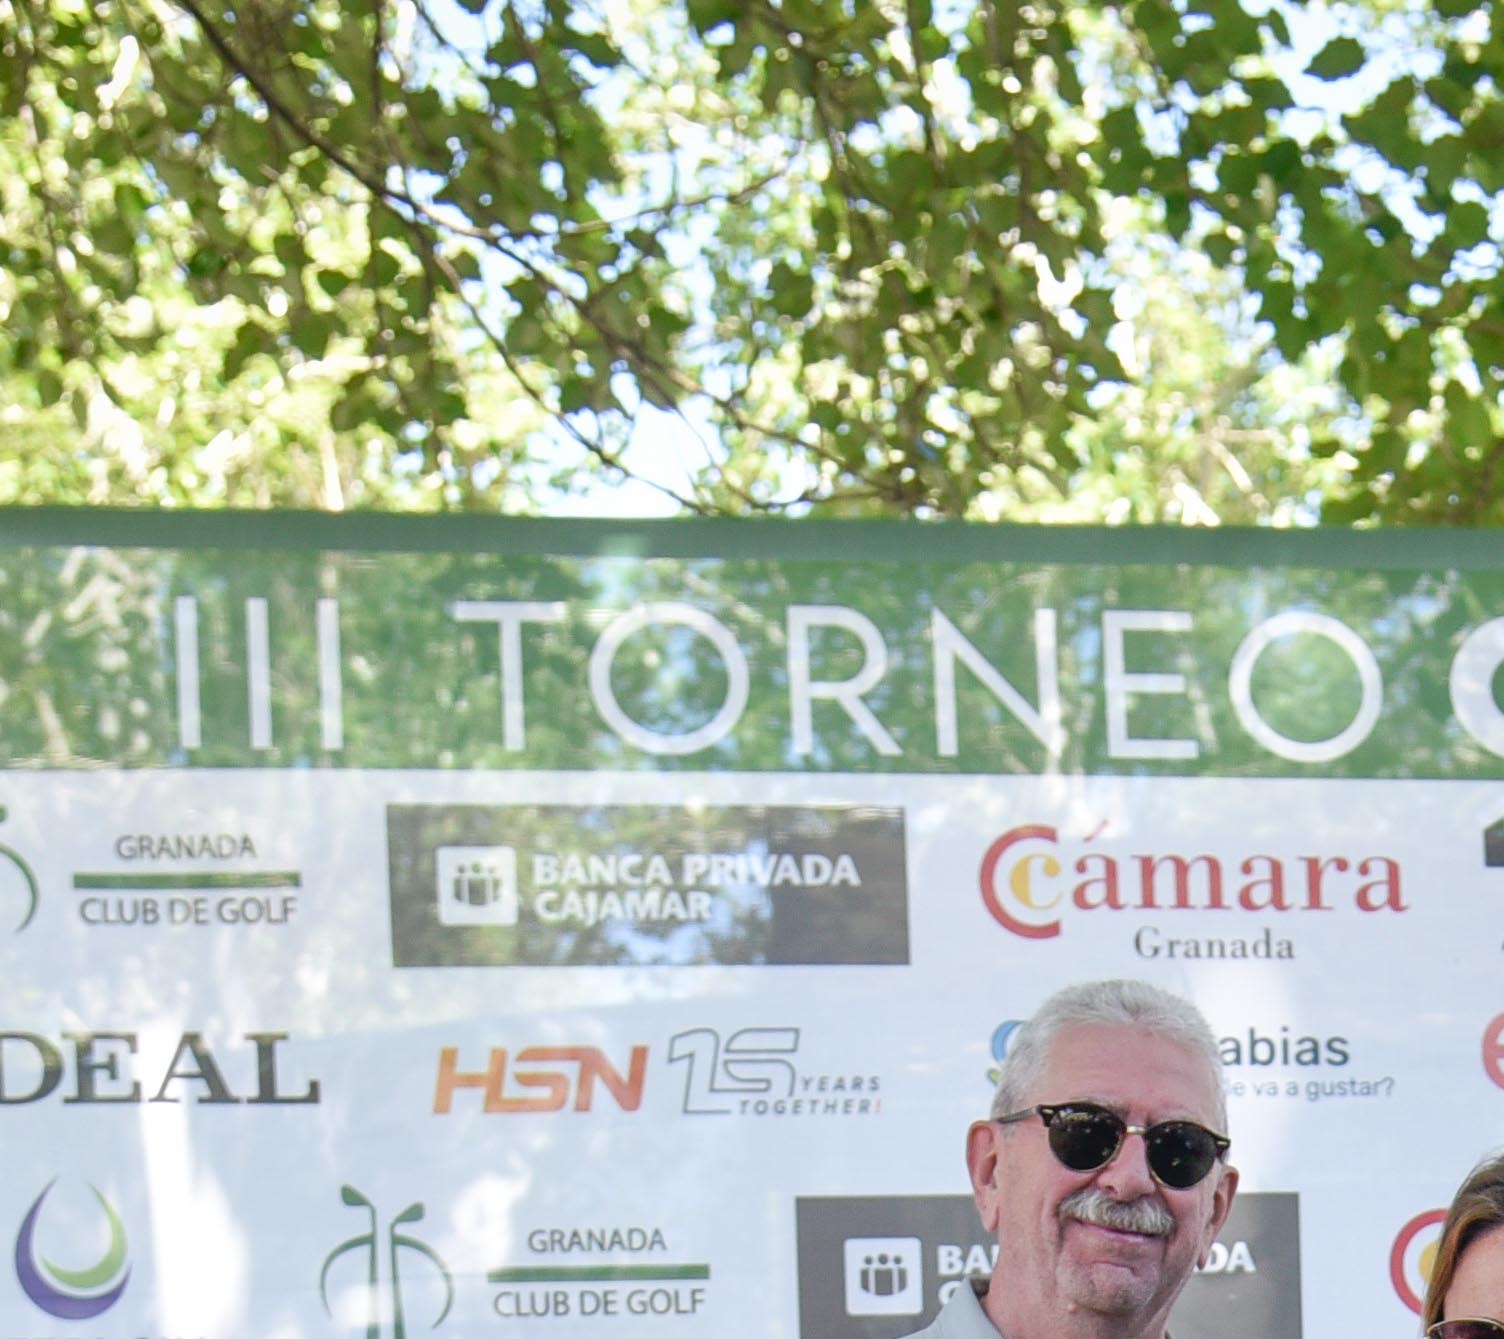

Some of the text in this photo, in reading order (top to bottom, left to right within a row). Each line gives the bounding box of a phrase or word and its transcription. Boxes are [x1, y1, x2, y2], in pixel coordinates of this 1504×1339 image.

[453, 600, 1383, 764] TORNEO
[116, 834, 257, 861] GRANADA
[532, 853, 861, 887] BANCA PRIVADA
[80, 896, 298, 927] CLUB DE GOLF
[535, 890, 712, 928] CAJAMAR
[1134, 926, 1295, 961] Granada
[1221, 1026, 1350, 1067] abias
[434, 1045, 649, 1114] HSN
[801, 1076, 882, 1092] YEARS
[1251, 1077, 1394, 1101] va a gustar?
[737, 1098, 882, 1116] TOGETHER!
[527, 1227, 668, 1254] GRANADA
[493, 1287, 708, 1319] CLUB DE GOLF
